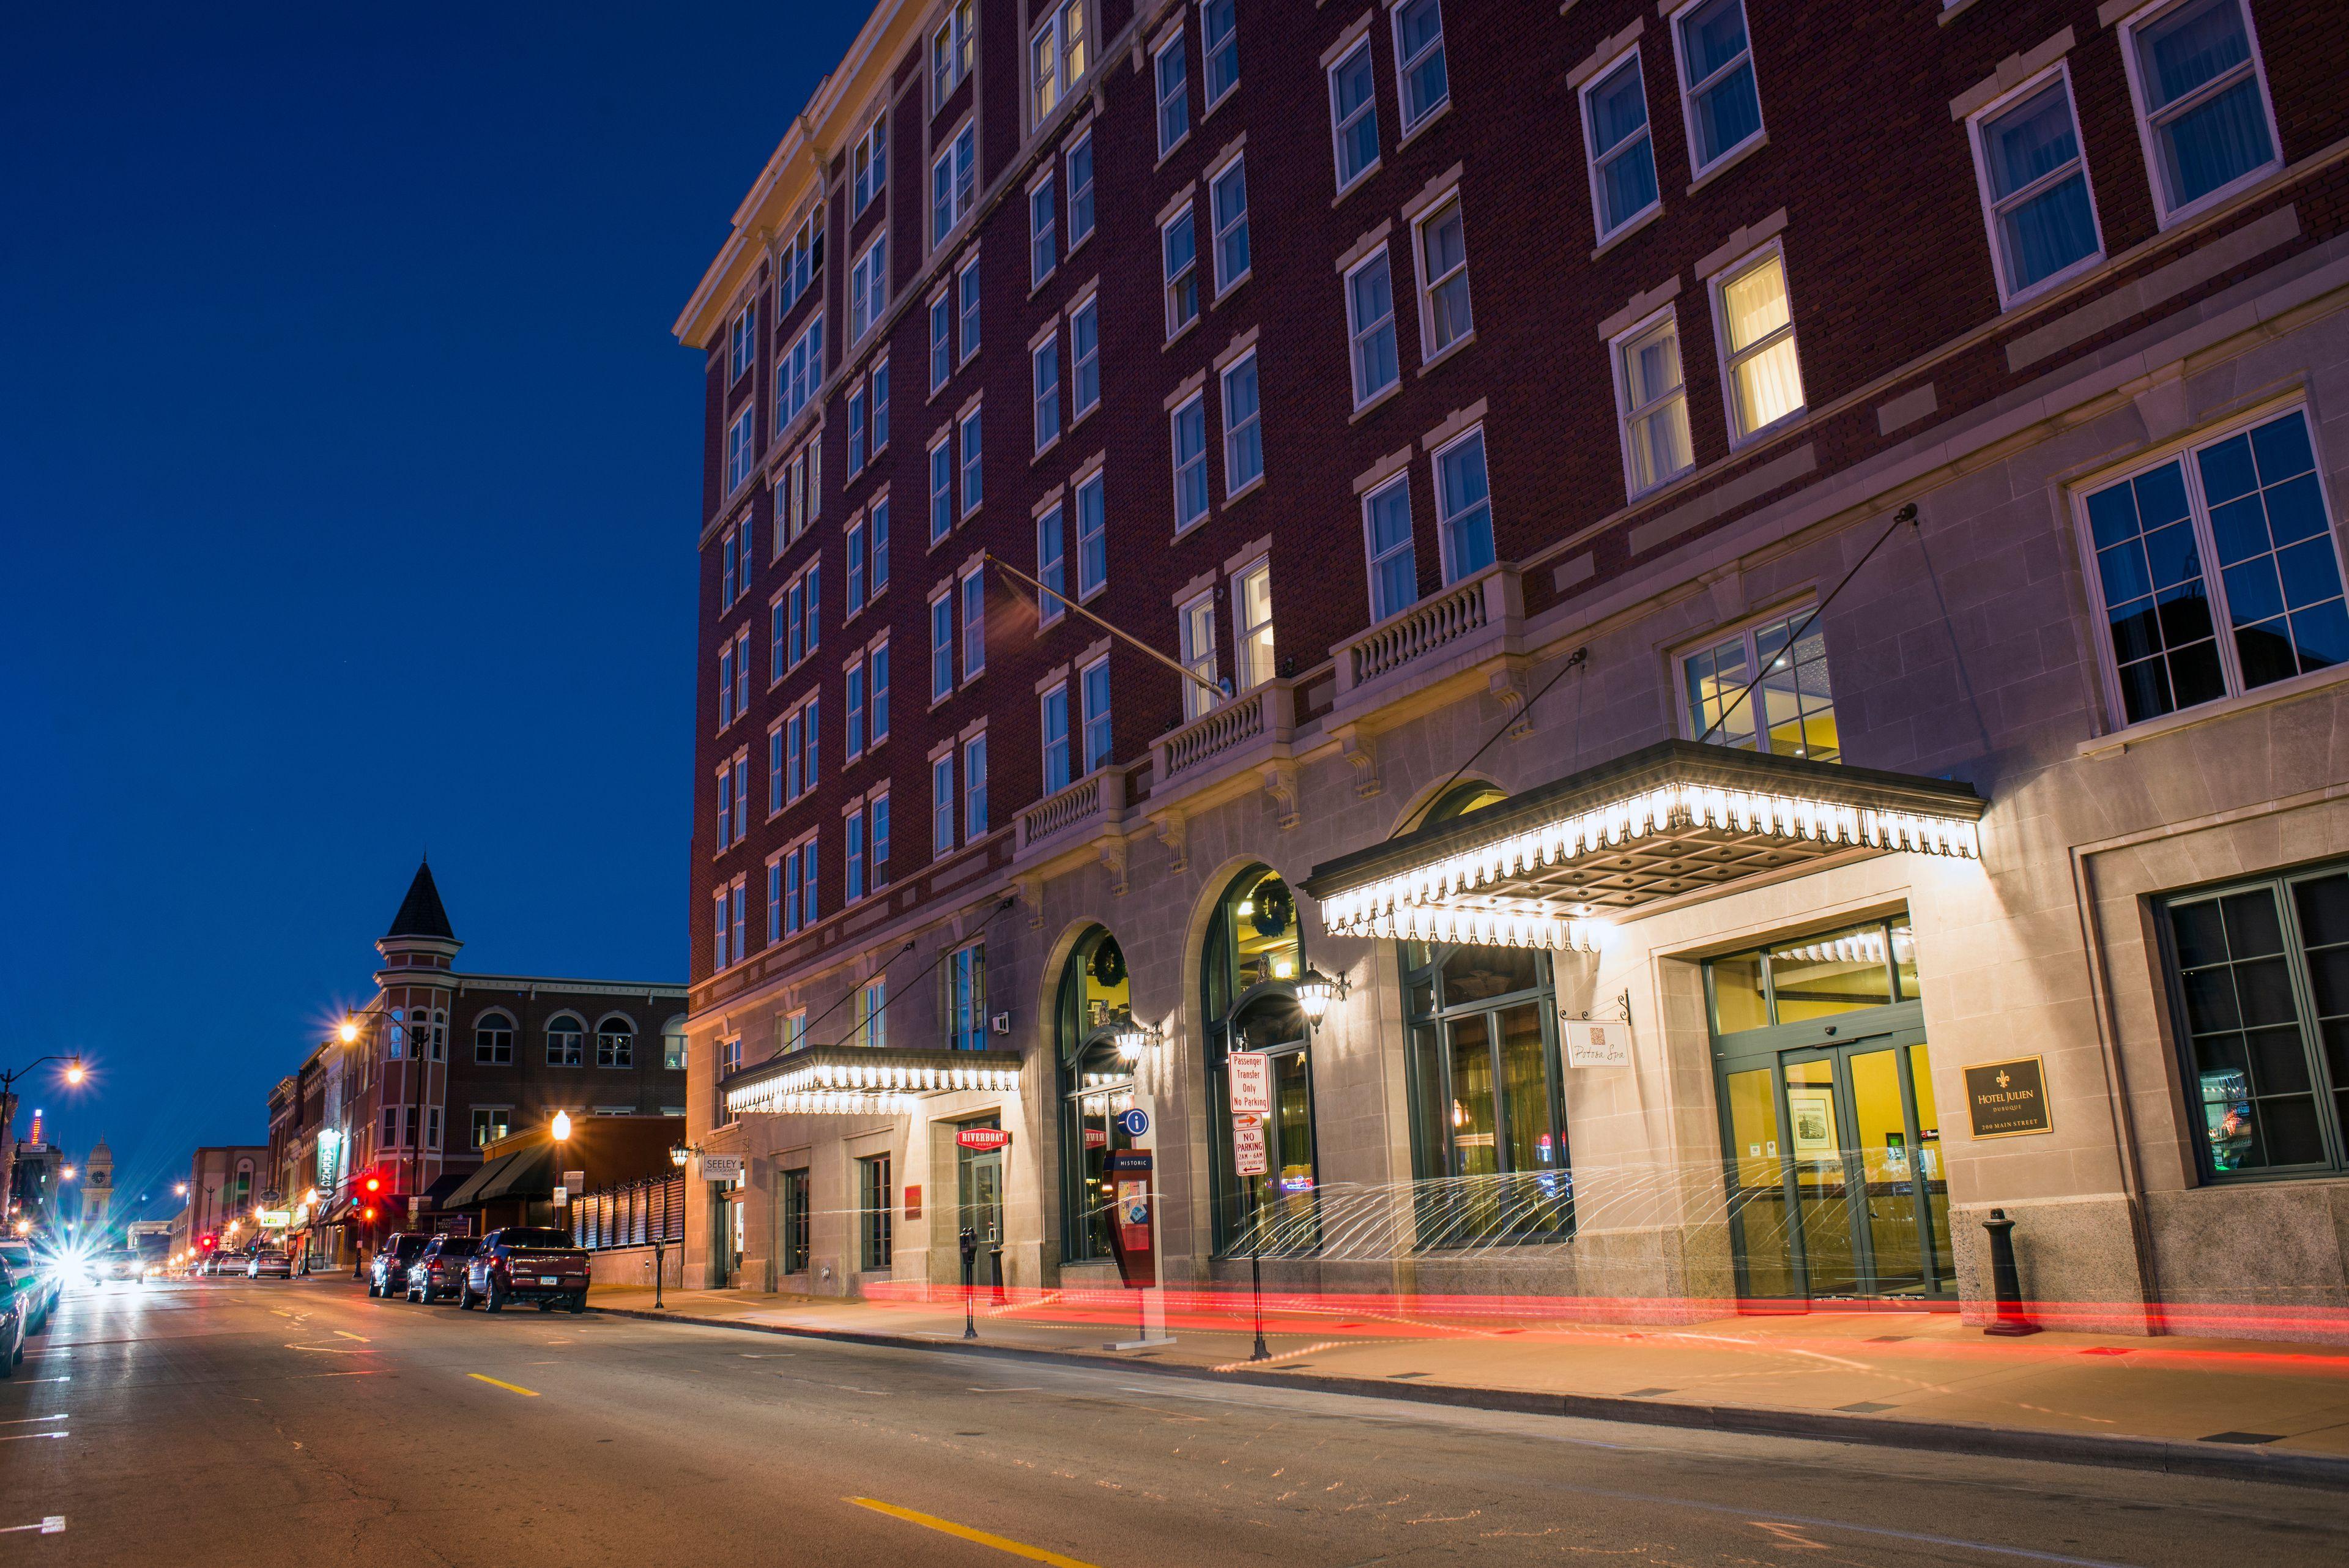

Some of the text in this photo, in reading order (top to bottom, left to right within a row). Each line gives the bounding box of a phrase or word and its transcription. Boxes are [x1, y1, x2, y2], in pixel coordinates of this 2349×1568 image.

[1607, 1044, 1625, 1061] Spa
[1234, 1056, 1261, 1068] Passenger
[1237, 1070, 1260, 1079] Transfer
[1242, 1083, 1256, 1094] Only
[1978, 1090, 2034, 1104] HOTEL JULIEN
[1234, 1097, 1266, 1109] No Parking
[962, 1133, 1004, 1142] RIVERBOAT
[1243, 1132, 1254, 1142] NO
[1238, 1142, 1263, 1151] PARKING
[707, 1159, 737, 1168] SEELEY
